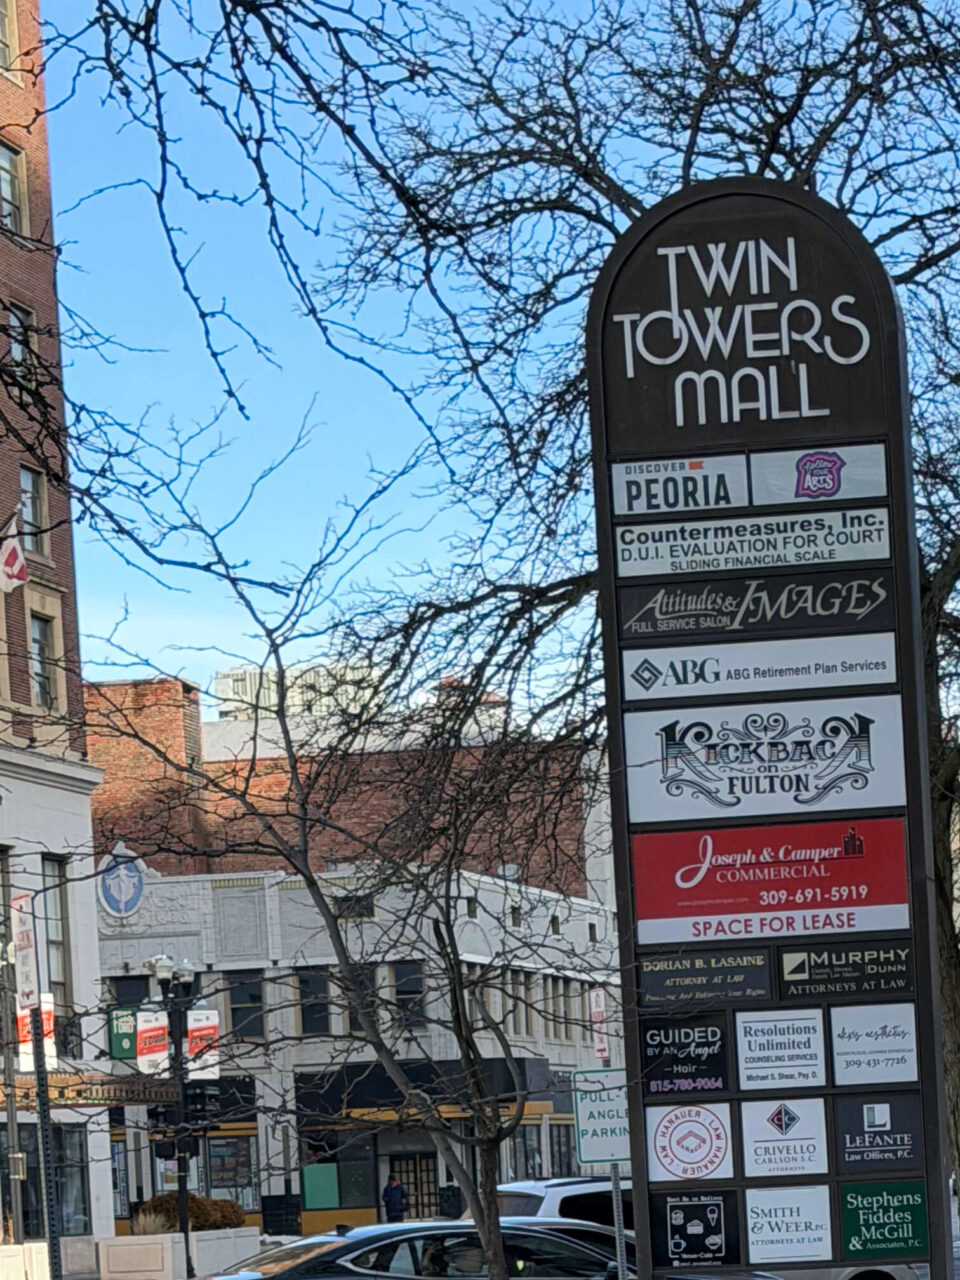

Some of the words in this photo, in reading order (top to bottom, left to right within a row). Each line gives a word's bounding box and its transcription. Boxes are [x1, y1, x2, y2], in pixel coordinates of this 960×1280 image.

[657, 237, 798, 339] TWIN
[613, 295, 870, 378] TOWERS
[674, 363, 830, 426] MALL
[625, 462, 686, 475] DISCOVER
[804, 474, 833, 491] ARTS
[625, 474, 732, 512] PEORIA
[620, 516, 833, 546] Countermeasures,
[841, 512, 884, 529] Inc.
[621, 547, 664, 562] D.U.I.
[670, 537, 778, 559] EVALUATION
[782, 533, 819, 549] FOR
[824, 528, 885, 547] COURT
[670, 557, 721, 572] SLIDING
[724, 552, 791, 569] FINANCIAL
[794, 549, 837, 562] SCALE
[625, 584, 723, 628] Attitudes
[726, 577, 887, 630] IMAGES
[631, 621, 654, 633] FULL
[657, 618, 696, 631] SERVICE
[700, 615, 731, 629] SALON
[661, 658, 720, 686] ABG
[726, 669, 750, 681] ABG
[753, 666, 811, 679] Retirement
[814, 662, 838, 675] Plan
[841, 660, 887, 672] Services
[757, 764, 779, 774] on
[728, 774, 810, 795] FULTON
[675, 835, 756, 889] Joseph
[759, 848, 775, 863] &
[779, 845, 842, 863] Camper
[716, 864, 830, 883] COMMERCIAL
[759, 885, 868, 905] 309-691-5919
[692, 918, 753, 937] SPACE
[760, 916, 796, 933] FOR
[802, 912, 856, 930] LEASE
[642, 959, 690, 971] DORIAN
[695, 959, 707, 968] B.
[711, 955, 765, 968] LASAINE
[810, 948, 909, 966] MURPHY
[867, 964, 907, 974] DUNN
[664, 976, 708, 986] ATTORNEY
[712, 975, 724, 983] AT
[727, 974, 745, 983] LAW
[788, 982, 857, 995] ATTORNEYS
[862, 981, 876, 990] AT
[881, 979, 906, 989] LAW
[646, 1026, 721, 1045] GUIDED
[743, 1023, 817, 1038] Resolutions
[646, 1047, 660, 1056] BY
[663, 1046, 678, 1055] AN
[678, 1041, 721, 1061] Angel
[748, 1037, 811, 1052] Unlimited
[744, 1054, 786, 1064] COUNSELING
[787, 1053, 818, 1062] SERVICES
[844, 1055, 907, 1069] 309-431-7726
[673, 1064, 697, 1074] Hair
[587, 1108, 630, 1121] ANGLE
[660, 1109, 702, 1138] HANAUER
[708, 1119, 724, 1141] LAW
[580, 1126, 631, 1139] PARKIN
[754, 1143, 817, 1157] CRIVELLO
[845, 1152, 861, 1161] Law
[864, 1150, 896, 1160] Offices,
[681, 1145, 723, 1176] HANAUER
[754, 1156, 798, 1165] CARLSON
[847, 1191, 922, 1211] Stephens
[750, 1206, 800, 1219] SMITH
[858, 1208, 912, 1225] Fiddes
[751, 1221, 764, 1234] &
[767, 1220, 815, 1233] WEER
[861, 1223, 913, 1240] McGill
[751, 1238, 794, 1246] ATTORNEYS
[849, 1235, 863, 1250] &
[866, 1241, 907, 1249] Associates,
